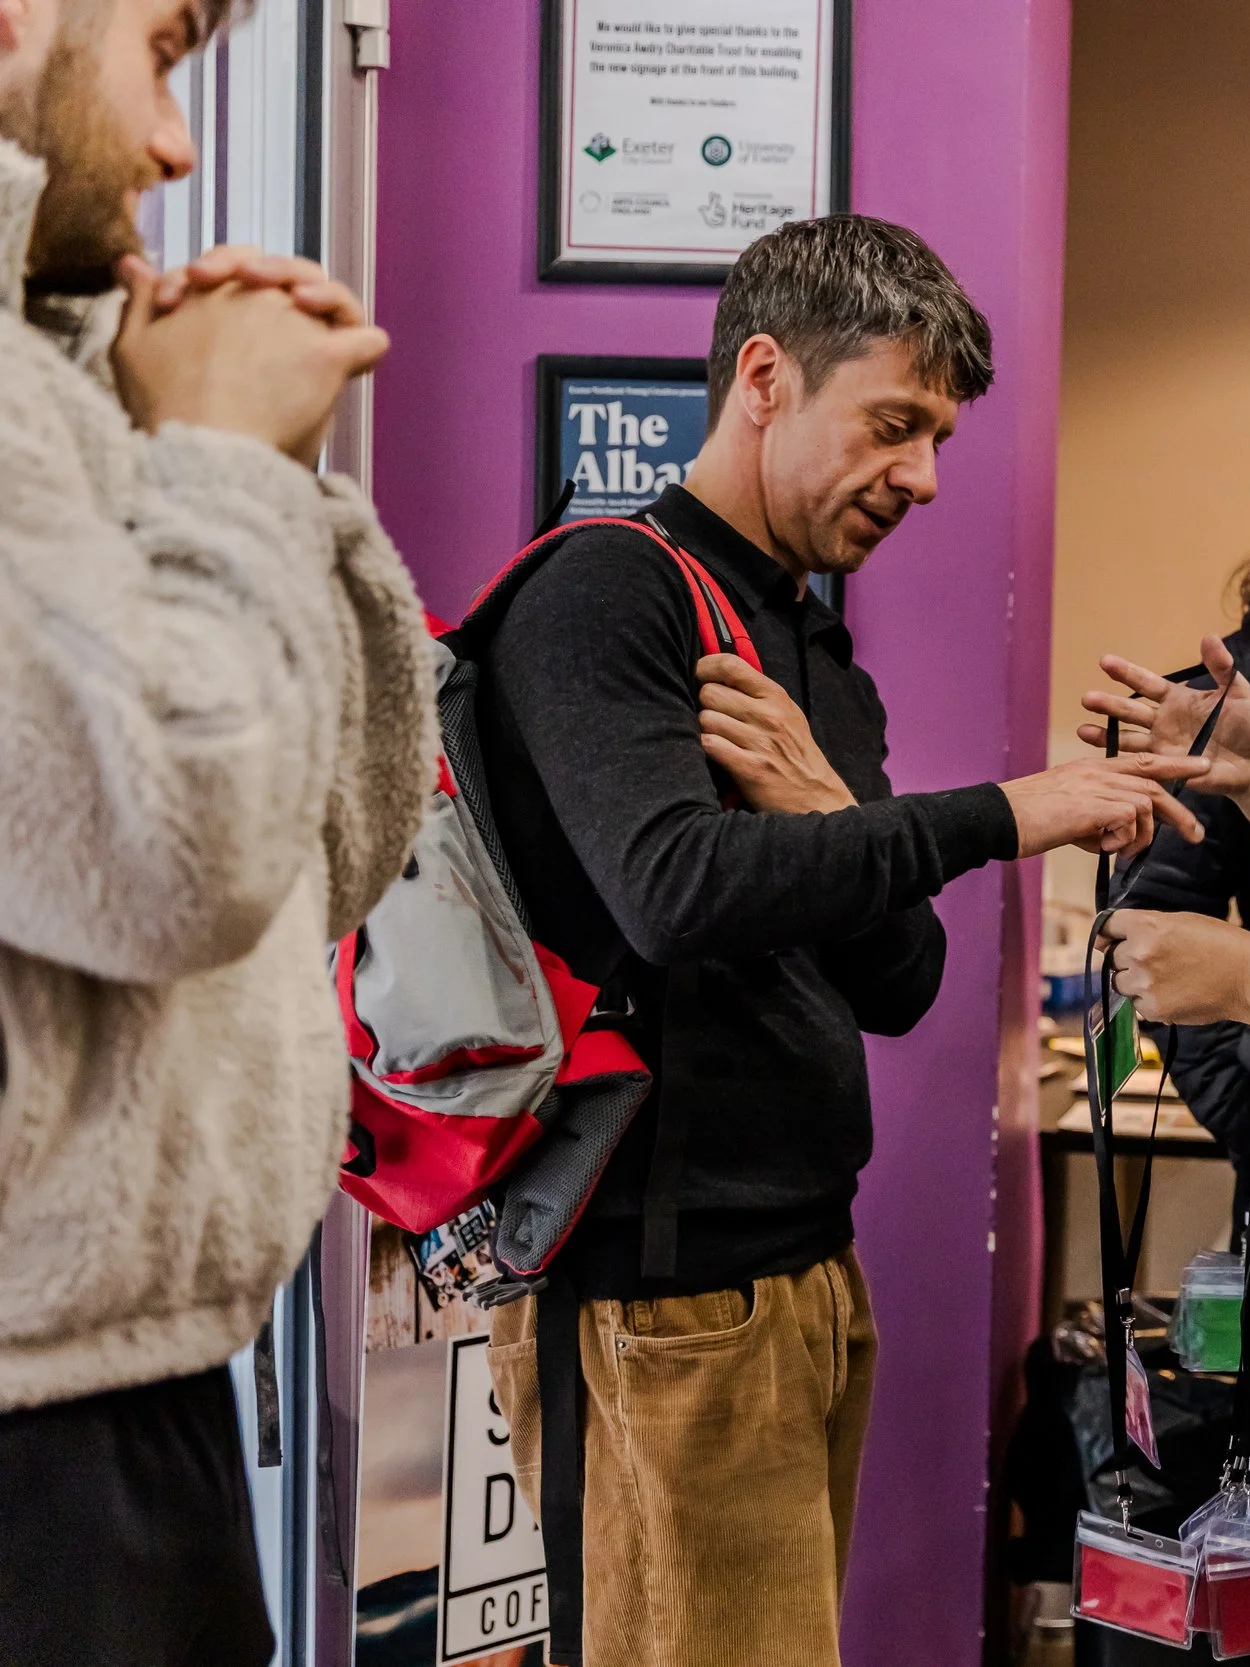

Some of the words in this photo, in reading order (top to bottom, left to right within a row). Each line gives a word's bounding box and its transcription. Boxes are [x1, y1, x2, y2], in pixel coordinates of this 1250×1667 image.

[615, 22, 641, 34] would
[645, 22, 661, 34] like
[664, 23, 673, 34] to
[676, 24, 696, 37] give
[699, 24, 733, 38] special
[736, 24, 768, 37] thanks
[771, 25, 780, 37] to
[783, 25, 799, 37] the
[589, 41, 630, 53] Veronica
[666, 42, 714, 55] Charitable
[718, 43, 742, 56] Trust
[745, 45, 757, 57] for
[761, 46, 802, 60] enabling
[590, 61, 604, 73] the
[609, 63, 627, 73] new
[631, 63, 667, 77] signage
[671, 64, 680, 75] at
[683, 64, 697, 75] the
[701, 64, 724, 76] front
[727, 64, 736, 76] of
[740, 65, 757, 77] this
[622, 137, 675, 155] Exeter
[732, 201, 794, 218] Heritage
[732, 215, 766, 230] Fund
[568, 400, 669, 448] The
